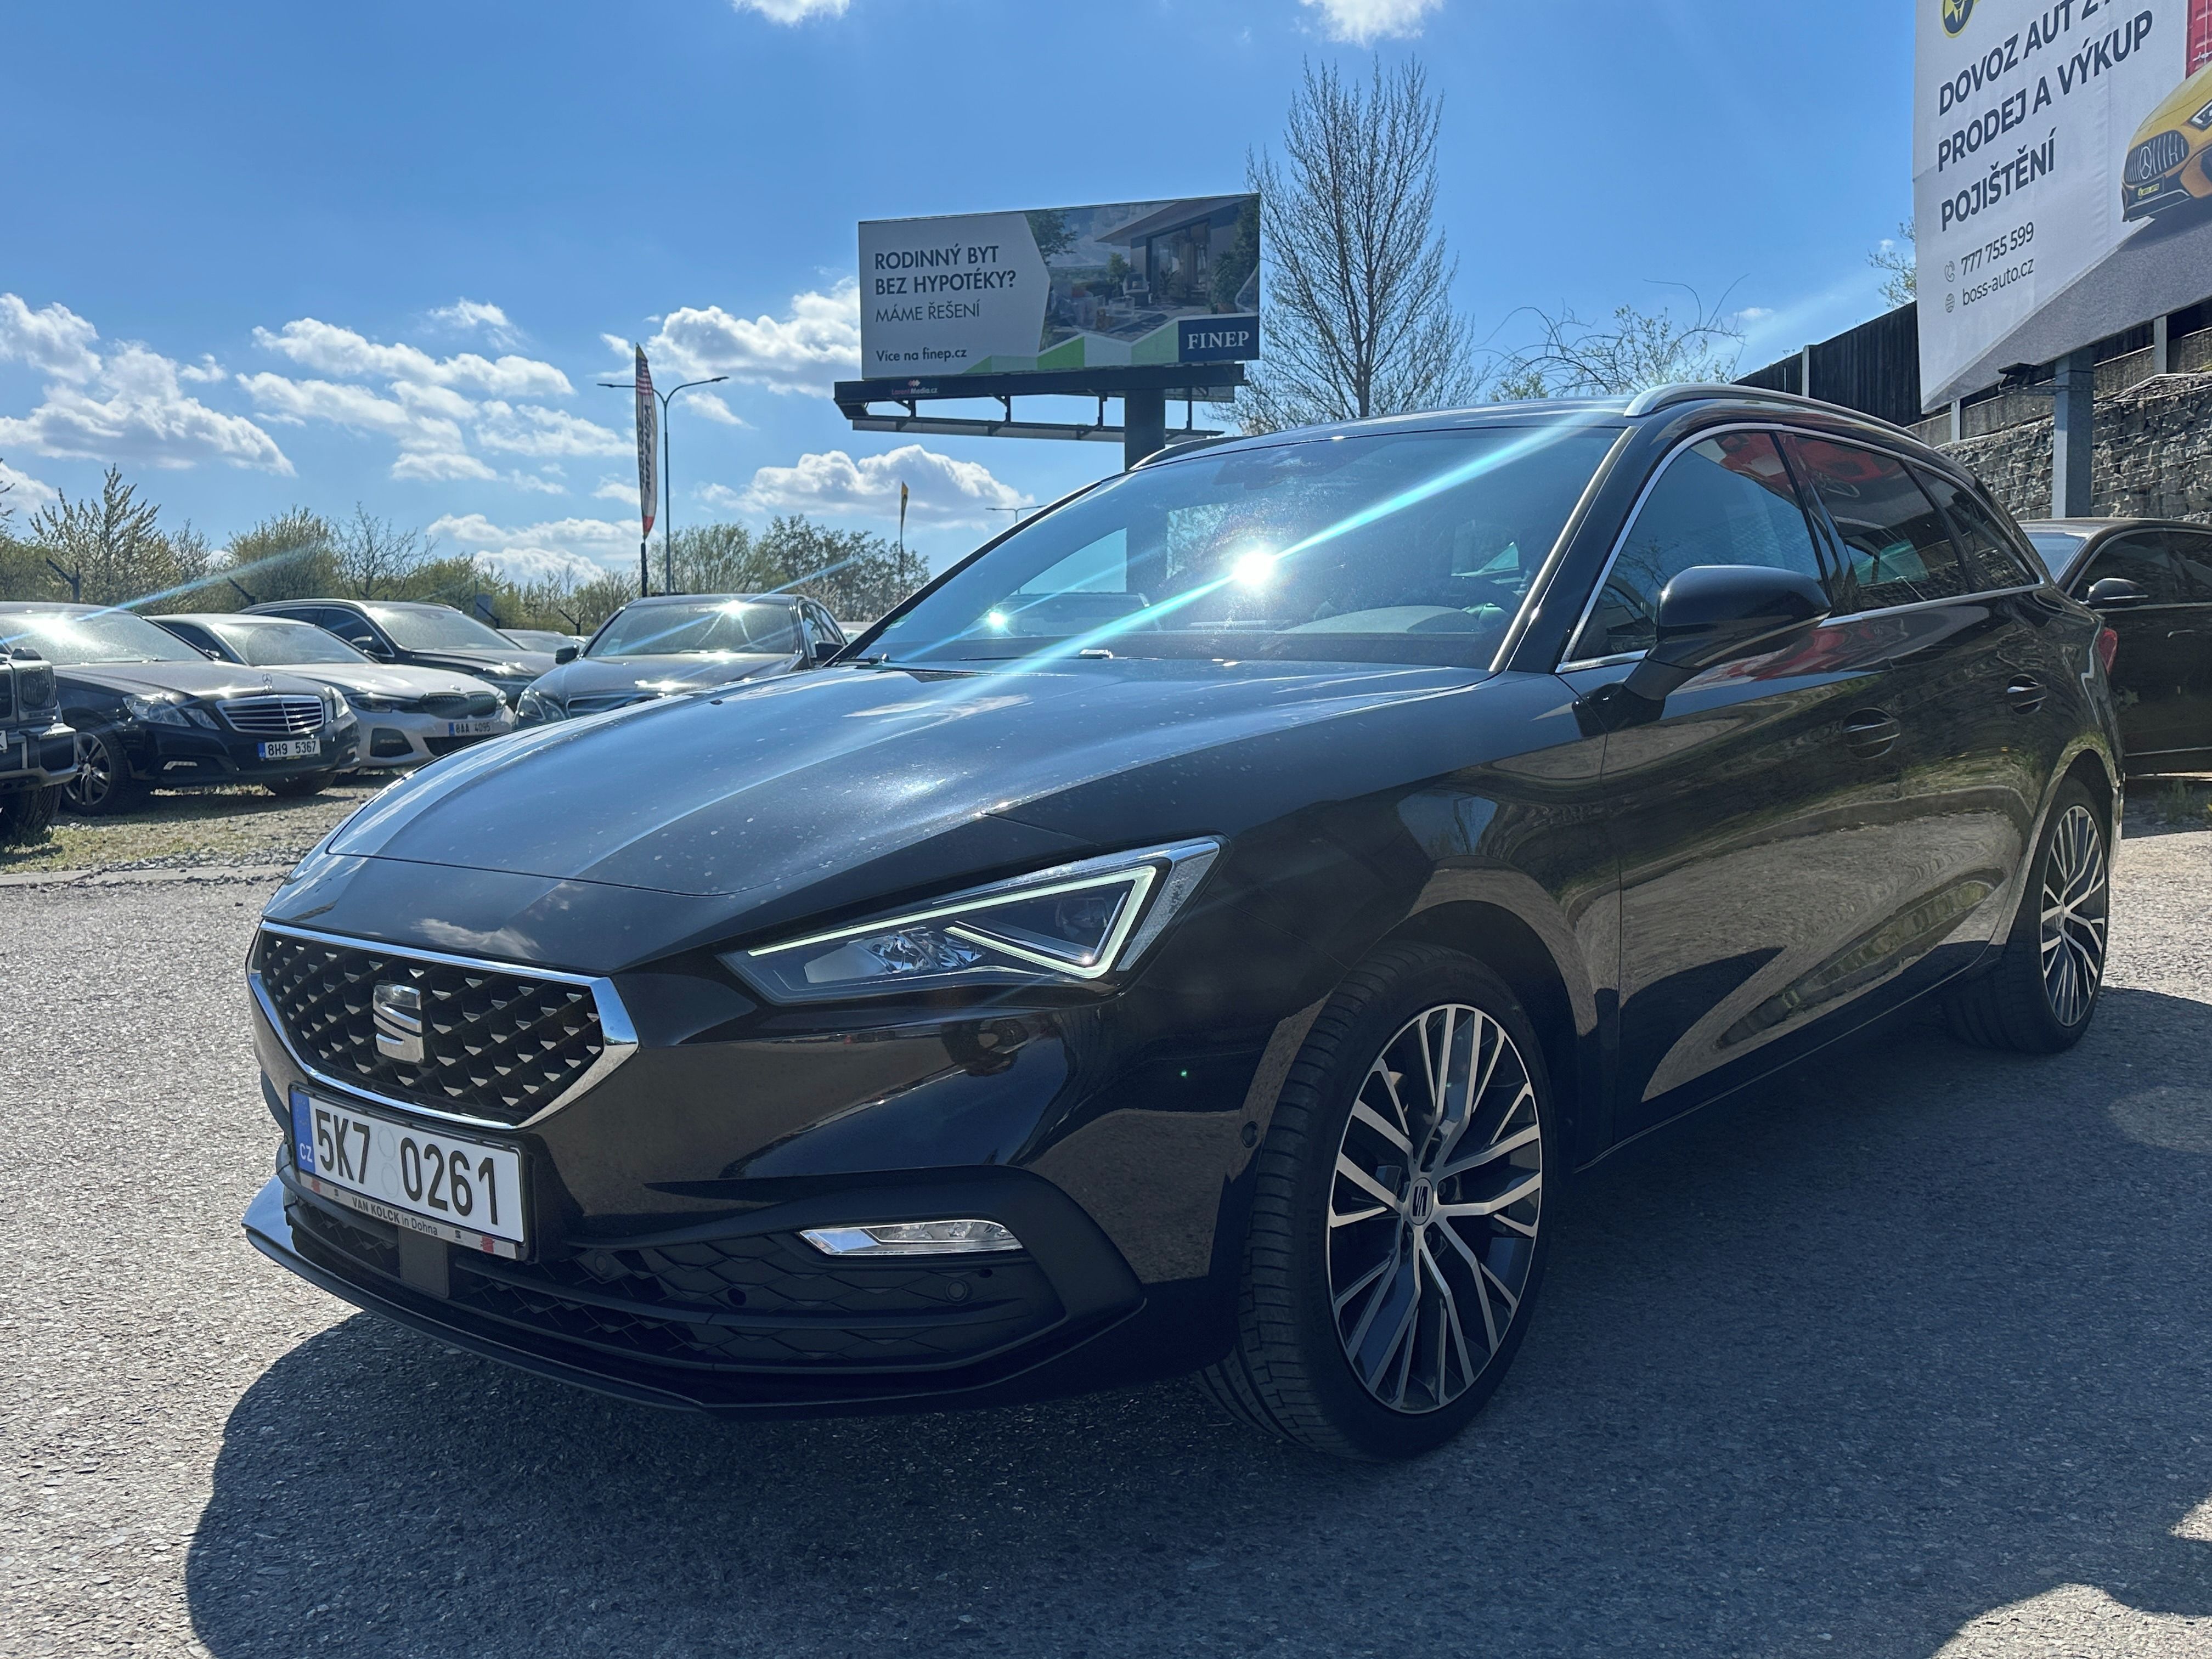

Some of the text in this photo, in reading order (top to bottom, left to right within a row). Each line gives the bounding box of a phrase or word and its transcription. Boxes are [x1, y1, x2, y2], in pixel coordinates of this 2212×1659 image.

[1939, 33, 2018, 116] DOVOZ
[2023, 0, 2075, 60] AUT
[1938, 10, 2153, 173] PRODEJ A VÝKUP
[1941, 127, 2057, 232] POJIŠTĚNÍ
[874, 243, 1000, 270] RODINNÝ BYT
[1961, 222, 2034, 275] 777 755 599
[875, 268, 1017, 296] BEZ HYPOTÉKY?
[1962, 258, 2034, 306] boss-auto.cz
[875, 298, 981, 323] MÁME ŘEŠENÍ
[876, 346, 968, 363] Více na finep.cz
[1187, 330, 1250, 350] FINEP
[455, 723, 470, 733] 8AA
[268, 743, 288, 756] 8H9
[295, 740, 317, 754] 5367
[300, 1108, 498, 1226] CZ 5K7 0261
[352, 1197, 438, 1235] VAN KOLCK in Dohna
